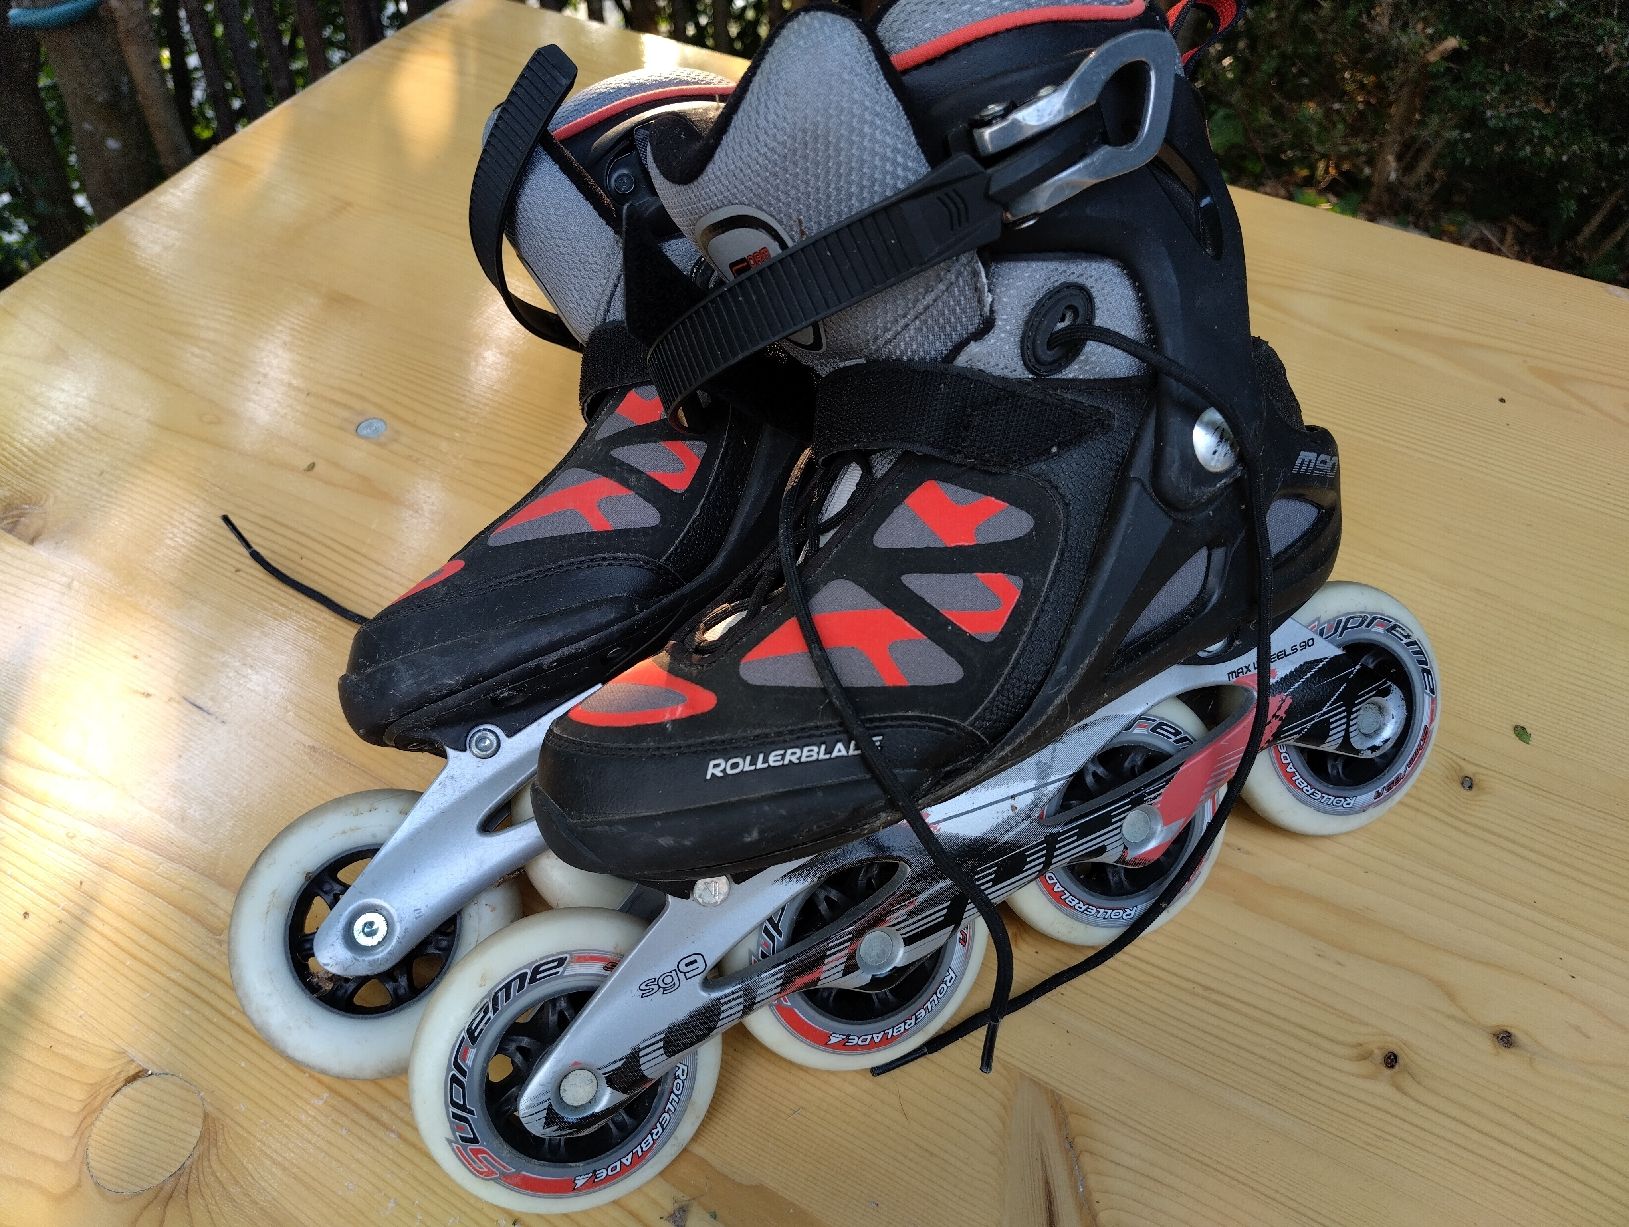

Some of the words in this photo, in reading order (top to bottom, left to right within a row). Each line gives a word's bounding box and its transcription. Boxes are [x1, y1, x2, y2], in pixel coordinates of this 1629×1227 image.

[1227, 663, 1252, 681] MAX
[705, 735, 884, 780] ROLLERBLA
[1044, 870, 1139, 920] ROLLERBLAD
[845, 966, 957, 1046] ROLLERBLADE
[593, 1062, 690, 1184] ROLLERBLADE
